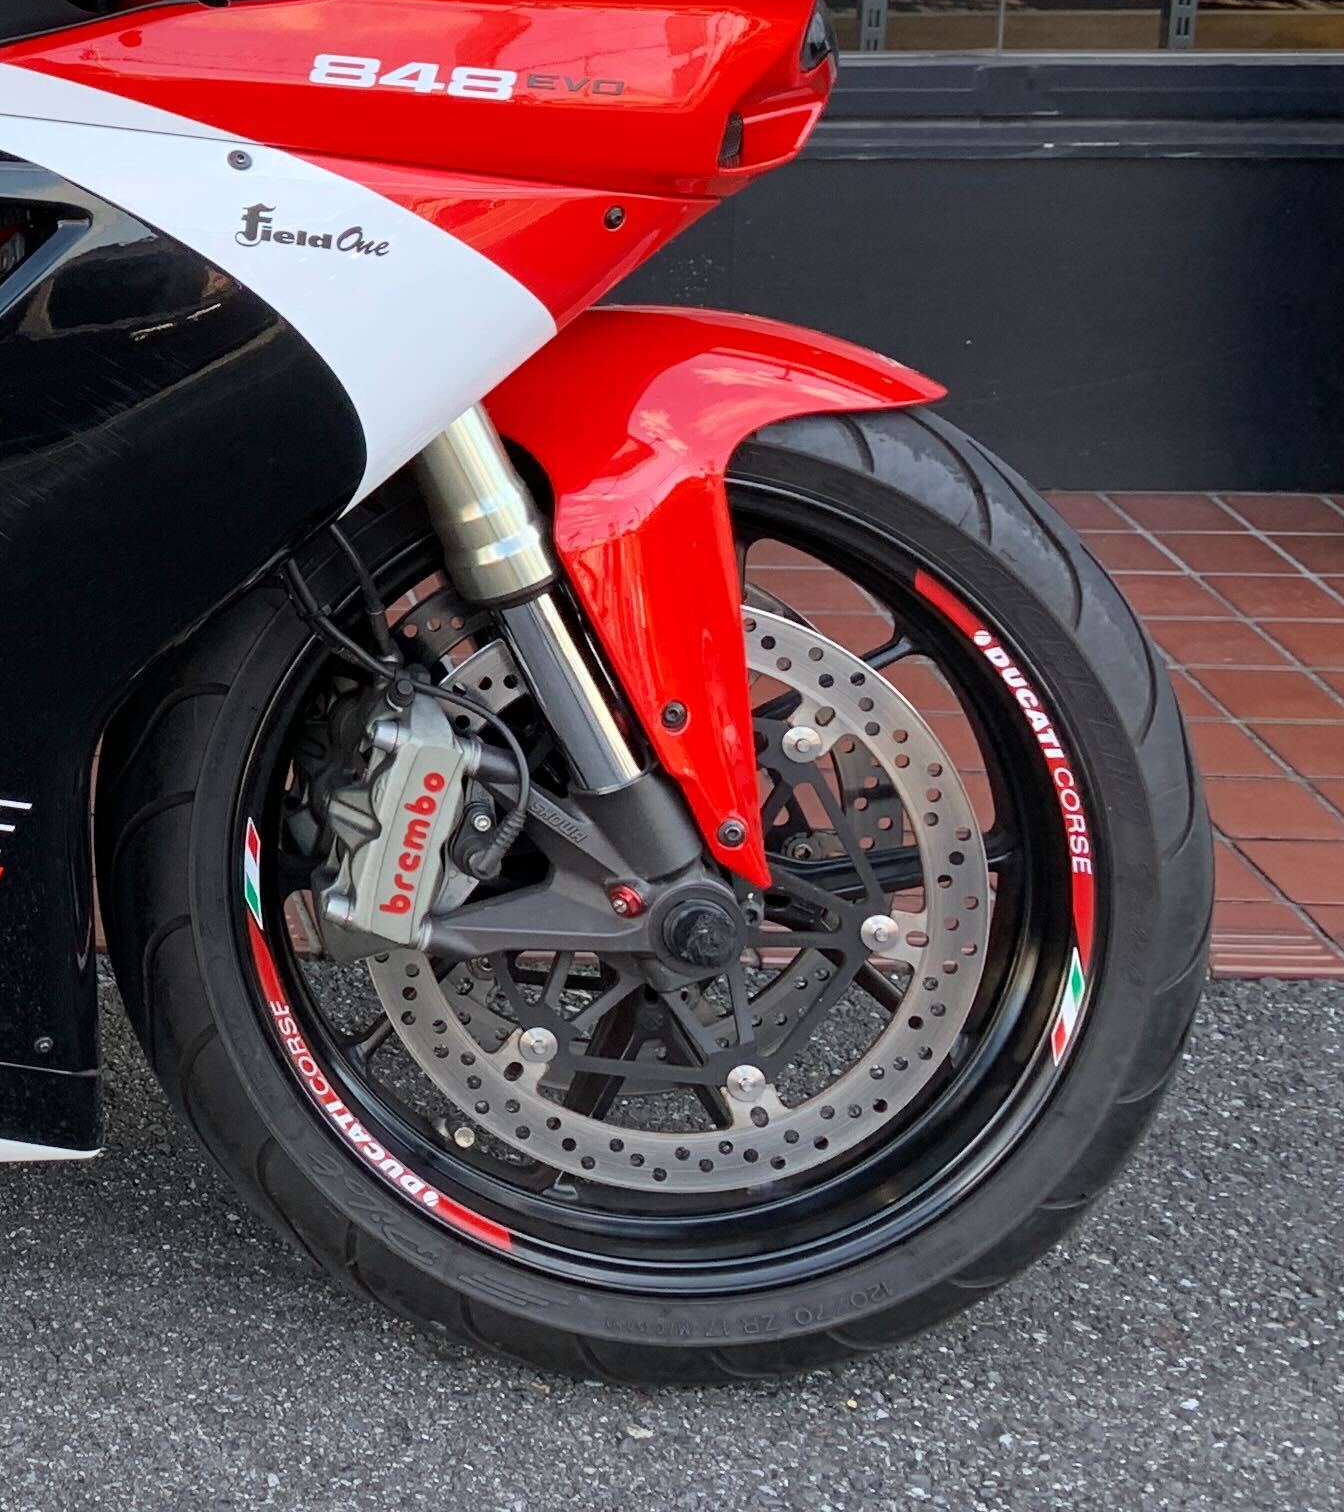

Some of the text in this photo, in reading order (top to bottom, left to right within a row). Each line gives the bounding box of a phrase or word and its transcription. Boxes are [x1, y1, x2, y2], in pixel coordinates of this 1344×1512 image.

[309, 53, 625, 102] 848 EVO
[379, 772, 445, 914] brembo
[983, 645, 1093, 876] DUCATI CORSE
[269, 999, 425, 1195] DUCATI CORSE
